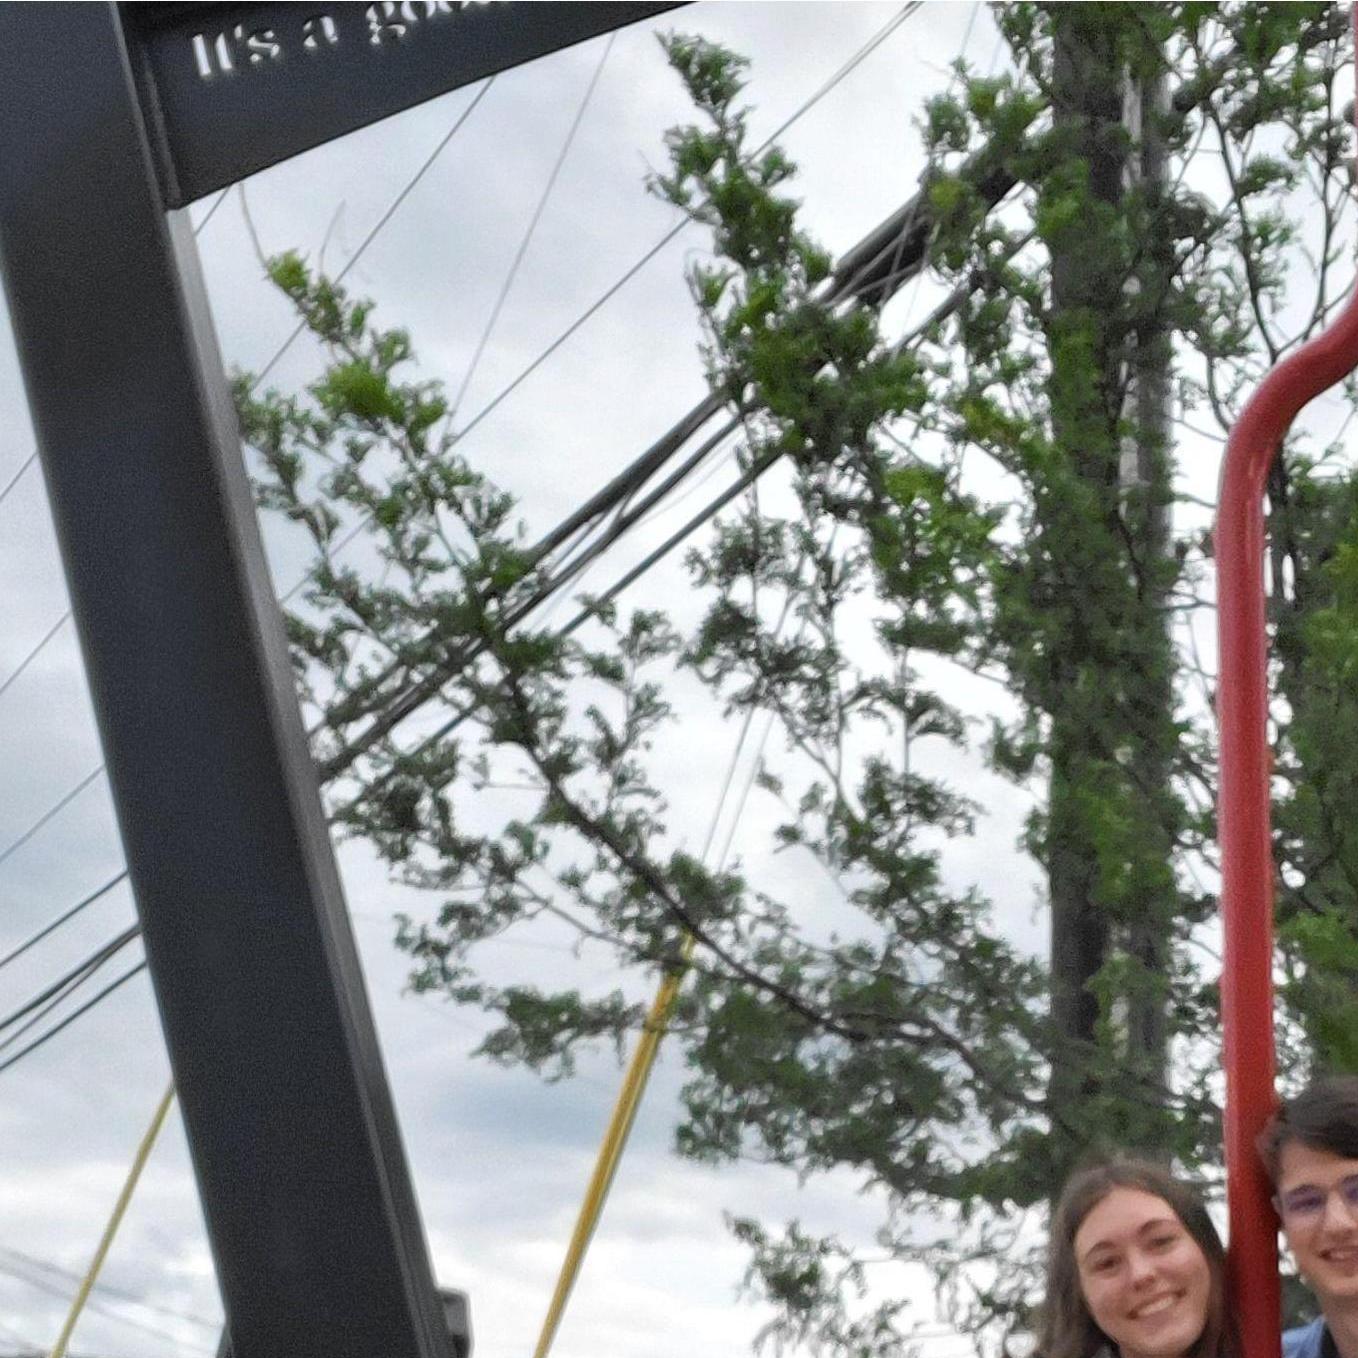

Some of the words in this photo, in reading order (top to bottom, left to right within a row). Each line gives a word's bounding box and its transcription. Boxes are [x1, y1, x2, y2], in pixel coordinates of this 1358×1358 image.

[192, 24, 280, 77] It's
[303, 15, 338, 48] a
[365, 0, 492, 46] go
